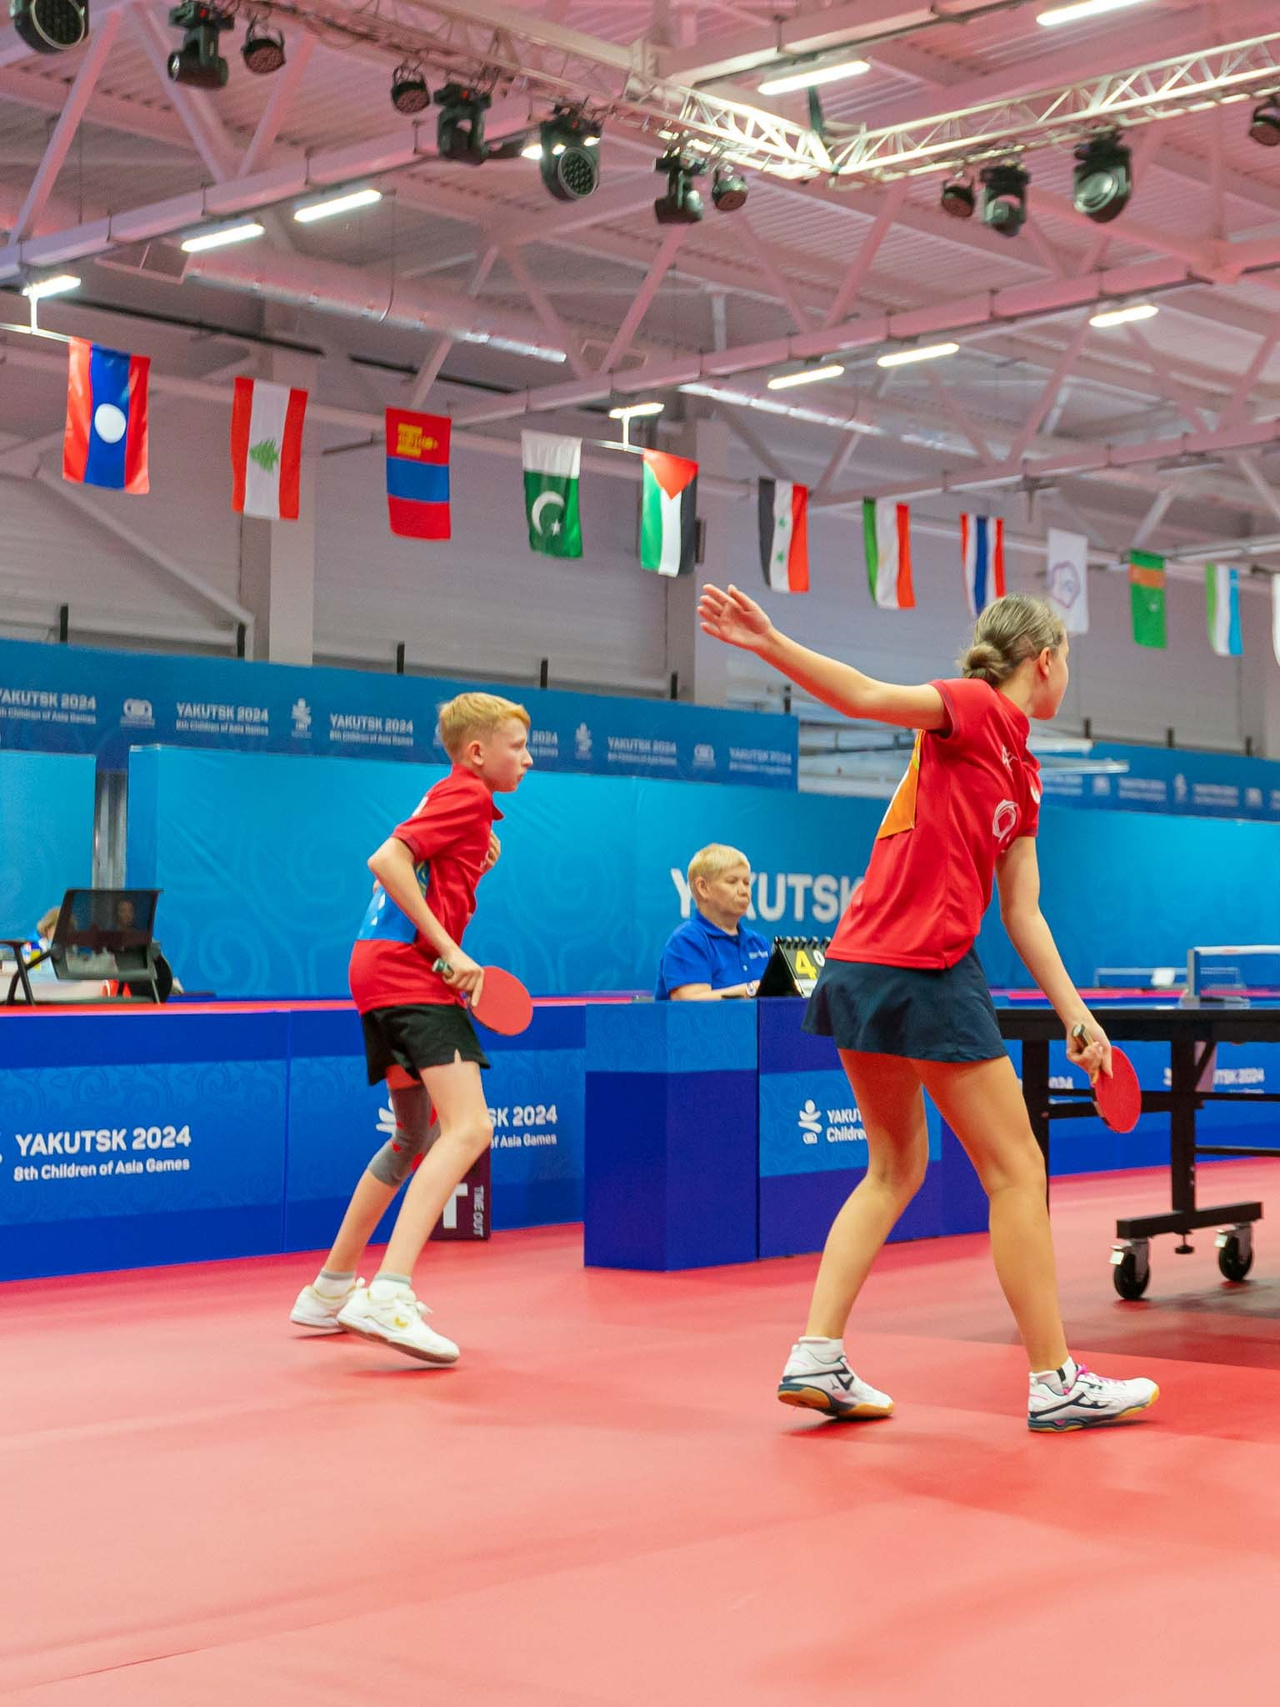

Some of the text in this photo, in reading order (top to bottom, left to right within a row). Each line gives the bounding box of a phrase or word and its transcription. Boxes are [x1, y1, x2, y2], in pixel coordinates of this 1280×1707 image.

[61, 693, 96, 711] 2024
[176, 702, 269, 723] YAKUTSK 2024
[330, 714, 413, 734] YAKUTSK 2024
[670, 868, 863, 923] YUTS
[795, 949, 818, 980] 4
[512, 1104, 558, 1127] 2024
[827, 1108, 862, 1124] YAKU
[15, 1125, 192, 1157] YAKUTSK 2024
[13, 1157, 190, 1182] 8th Children of Asia Games
[473, 1211, 484, 1237] OUT
